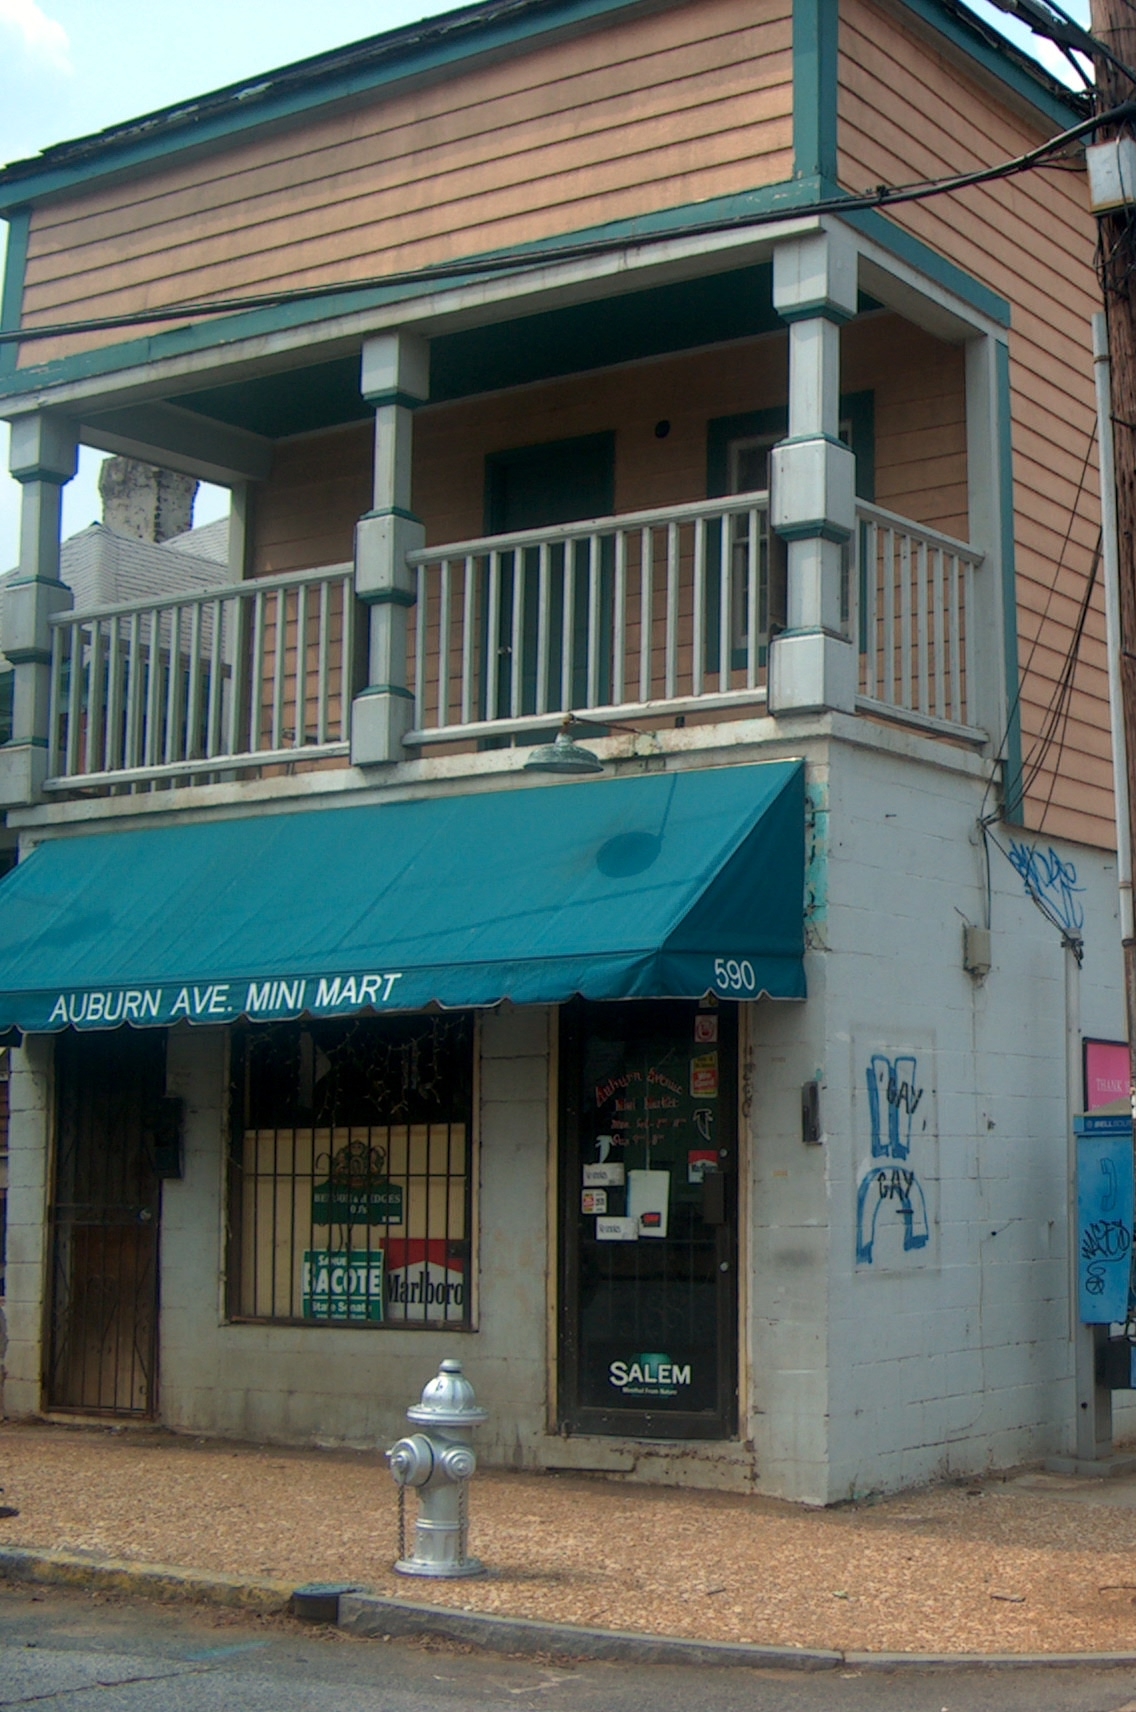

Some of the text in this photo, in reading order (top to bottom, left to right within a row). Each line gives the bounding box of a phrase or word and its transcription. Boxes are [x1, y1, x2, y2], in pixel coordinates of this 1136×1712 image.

[714, 958, 756, 991] 590
[48, 973, 403, 1023] AUBURN AVE. MINI MART
[886, 1076, 924, 1115] GAY
[1096, 1078, 1123, 1092] THANK
[878, 1170, 914, 1201] GAY
[303, 1261, 381, 1295] BACOTE
[386, 1271, 464, 1306] Marlboro
[609, 1360, 692, 1387] SALEM
